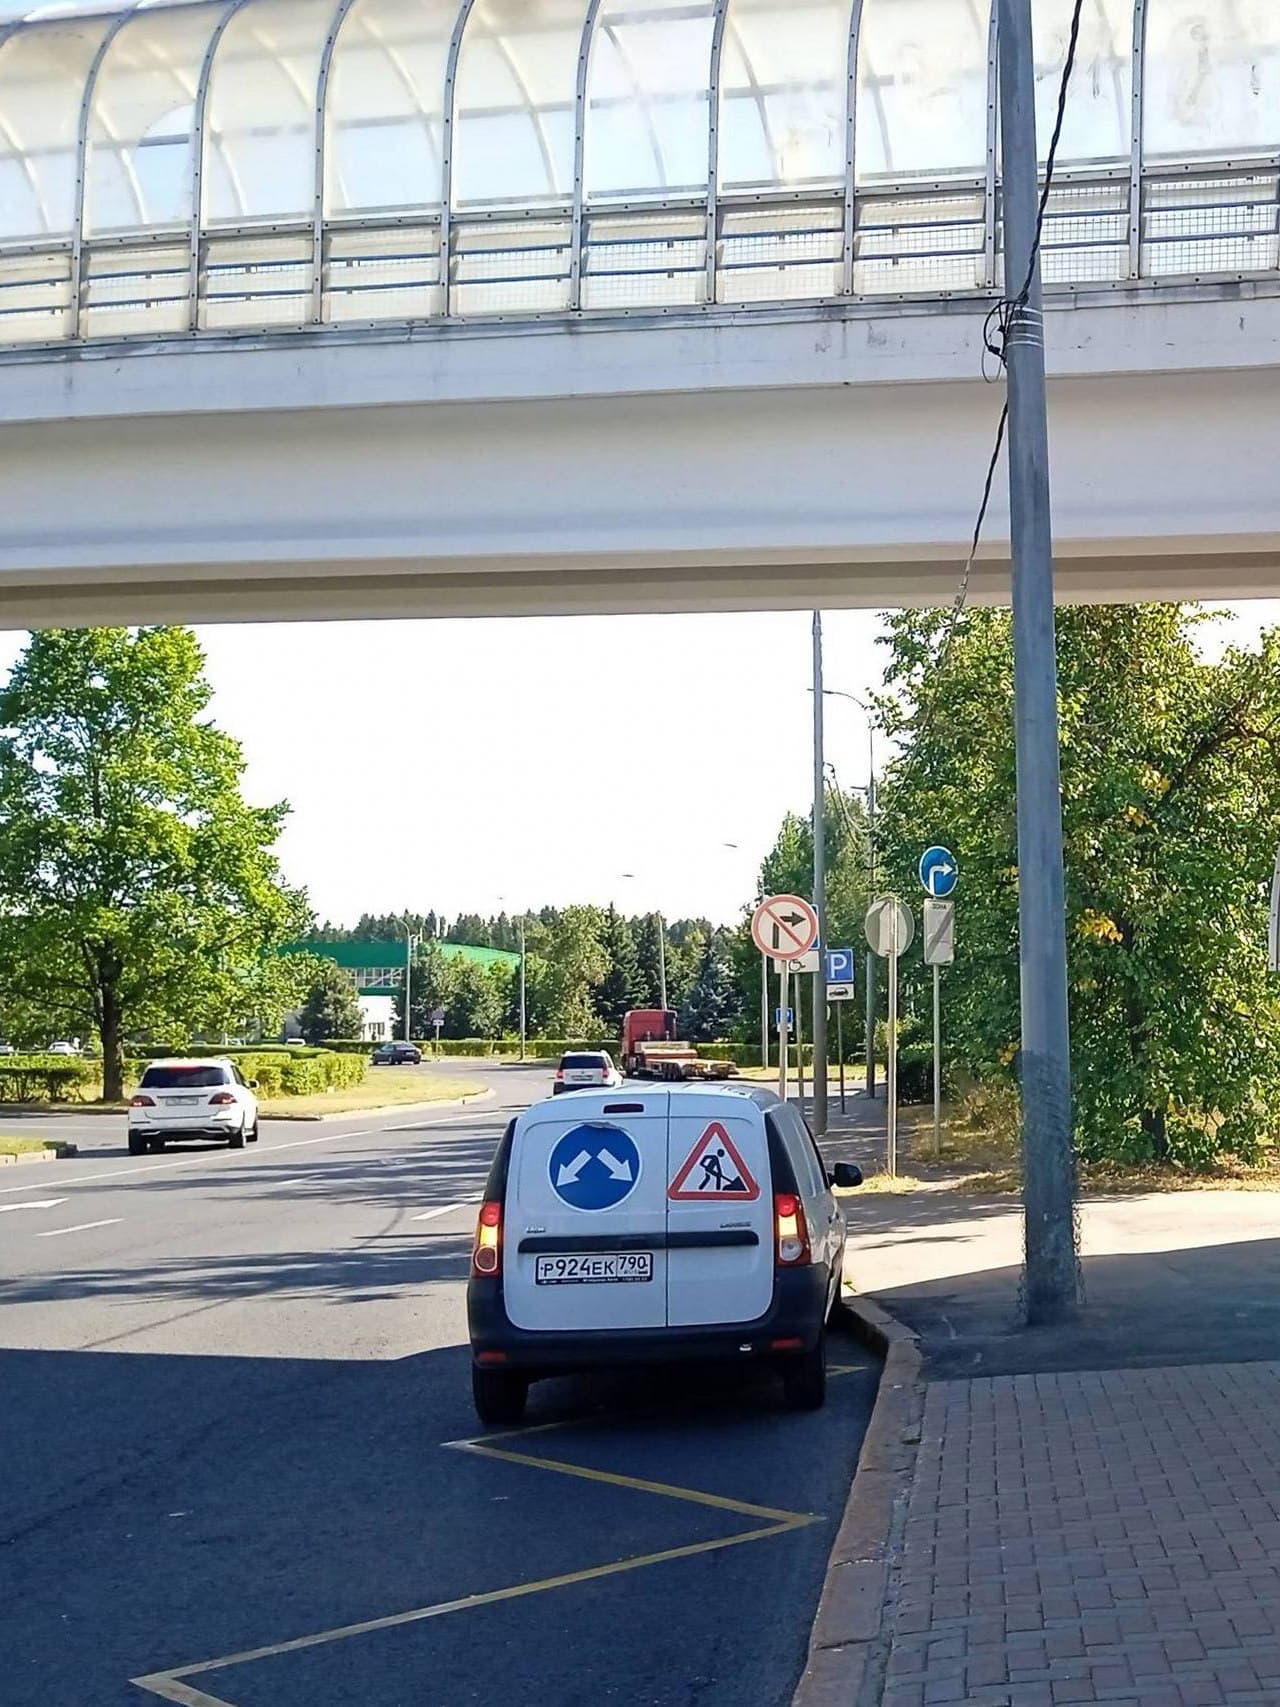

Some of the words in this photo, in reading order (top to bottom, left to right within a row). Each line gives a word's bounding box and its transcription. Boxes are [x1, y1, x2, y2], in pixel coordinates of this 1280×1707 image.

[831, 953, 848, 979] P
[543, 1258, 615, 1277] Р924ЕК
[618, 1256, 647, 1270] 790
